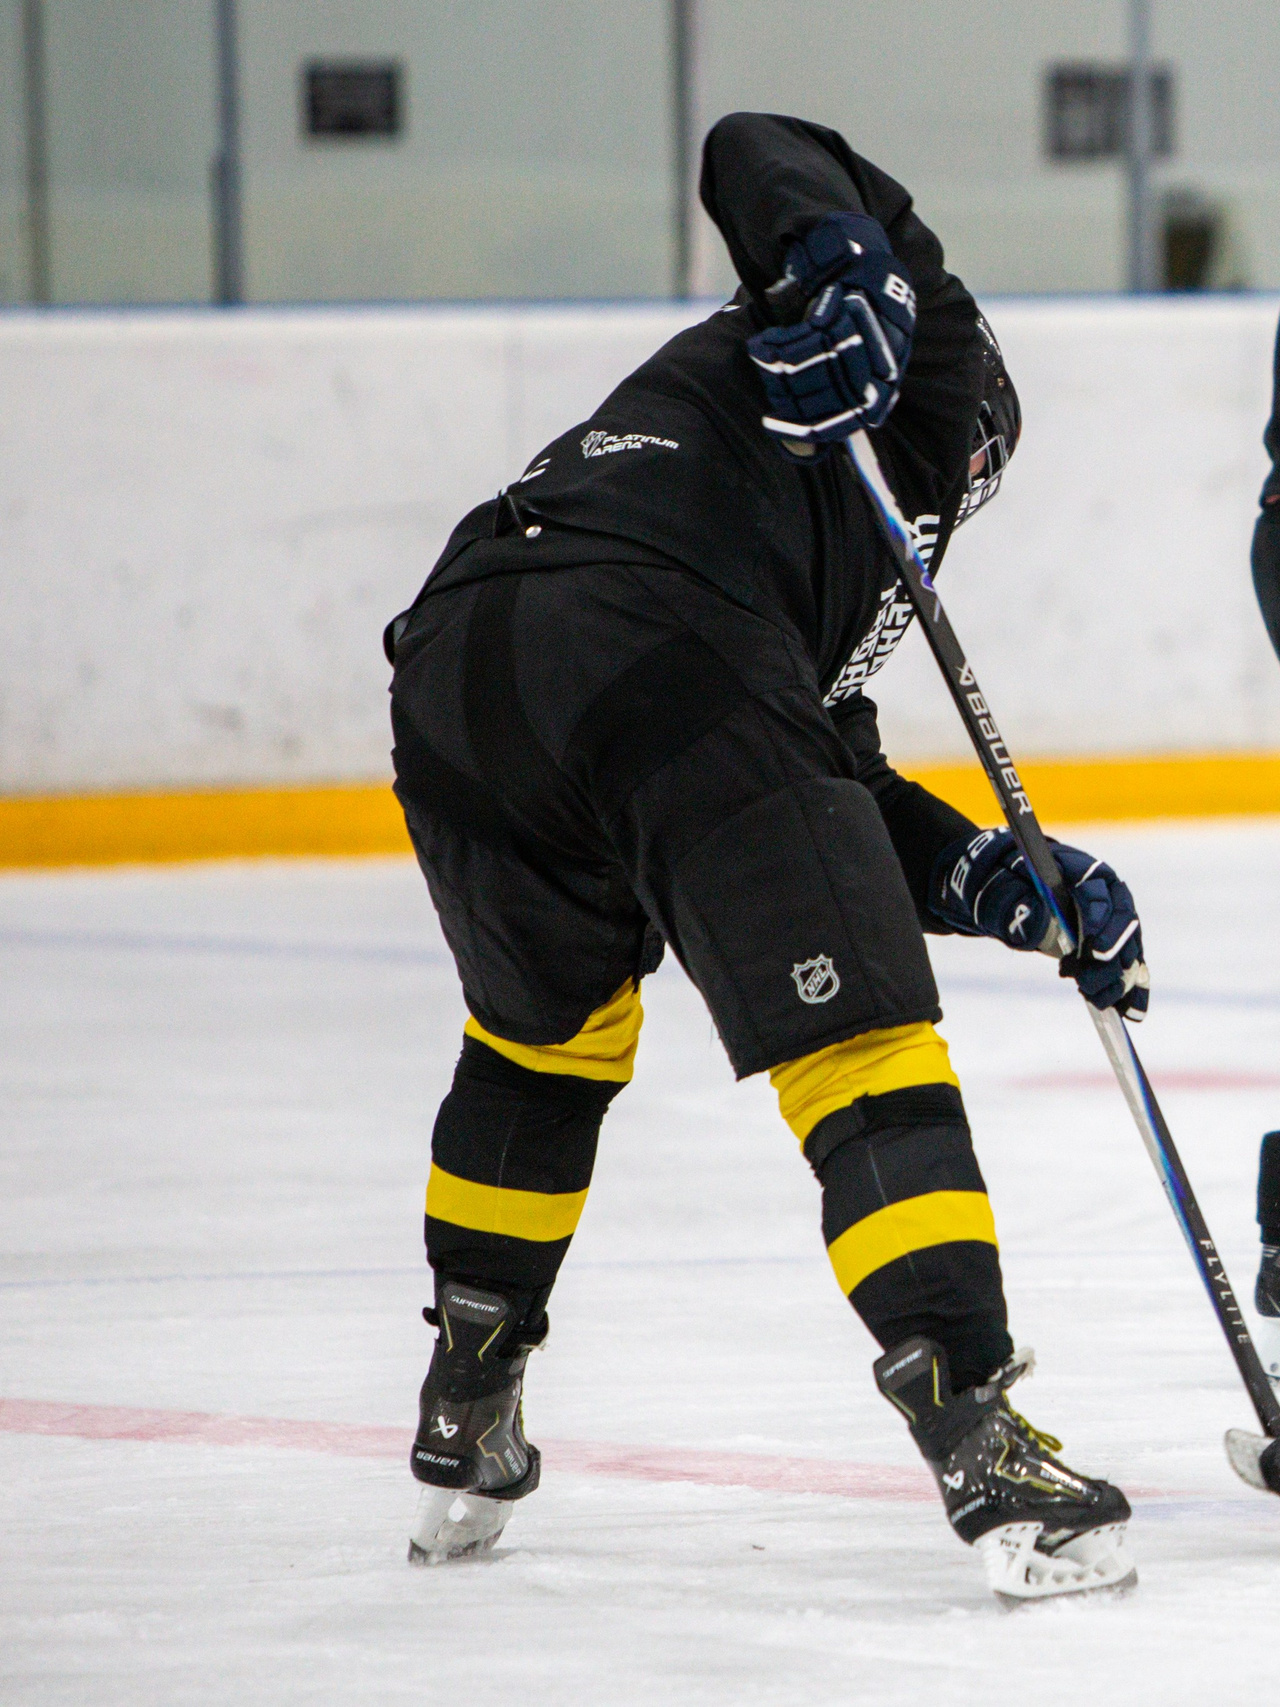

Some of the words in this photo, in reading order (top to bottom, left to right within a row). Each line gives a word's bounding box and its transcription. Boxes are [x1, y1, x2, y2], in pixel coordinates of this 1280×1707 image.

[590, 441, 642, 457] ARENA
[602, 434, 679, 450] PLATINUM
[966, 691, 1033, 816] BAUER
[1199, 1238, 1250, 1345] FLYLITE
[416, 1449, 460, 1469] BAUER
